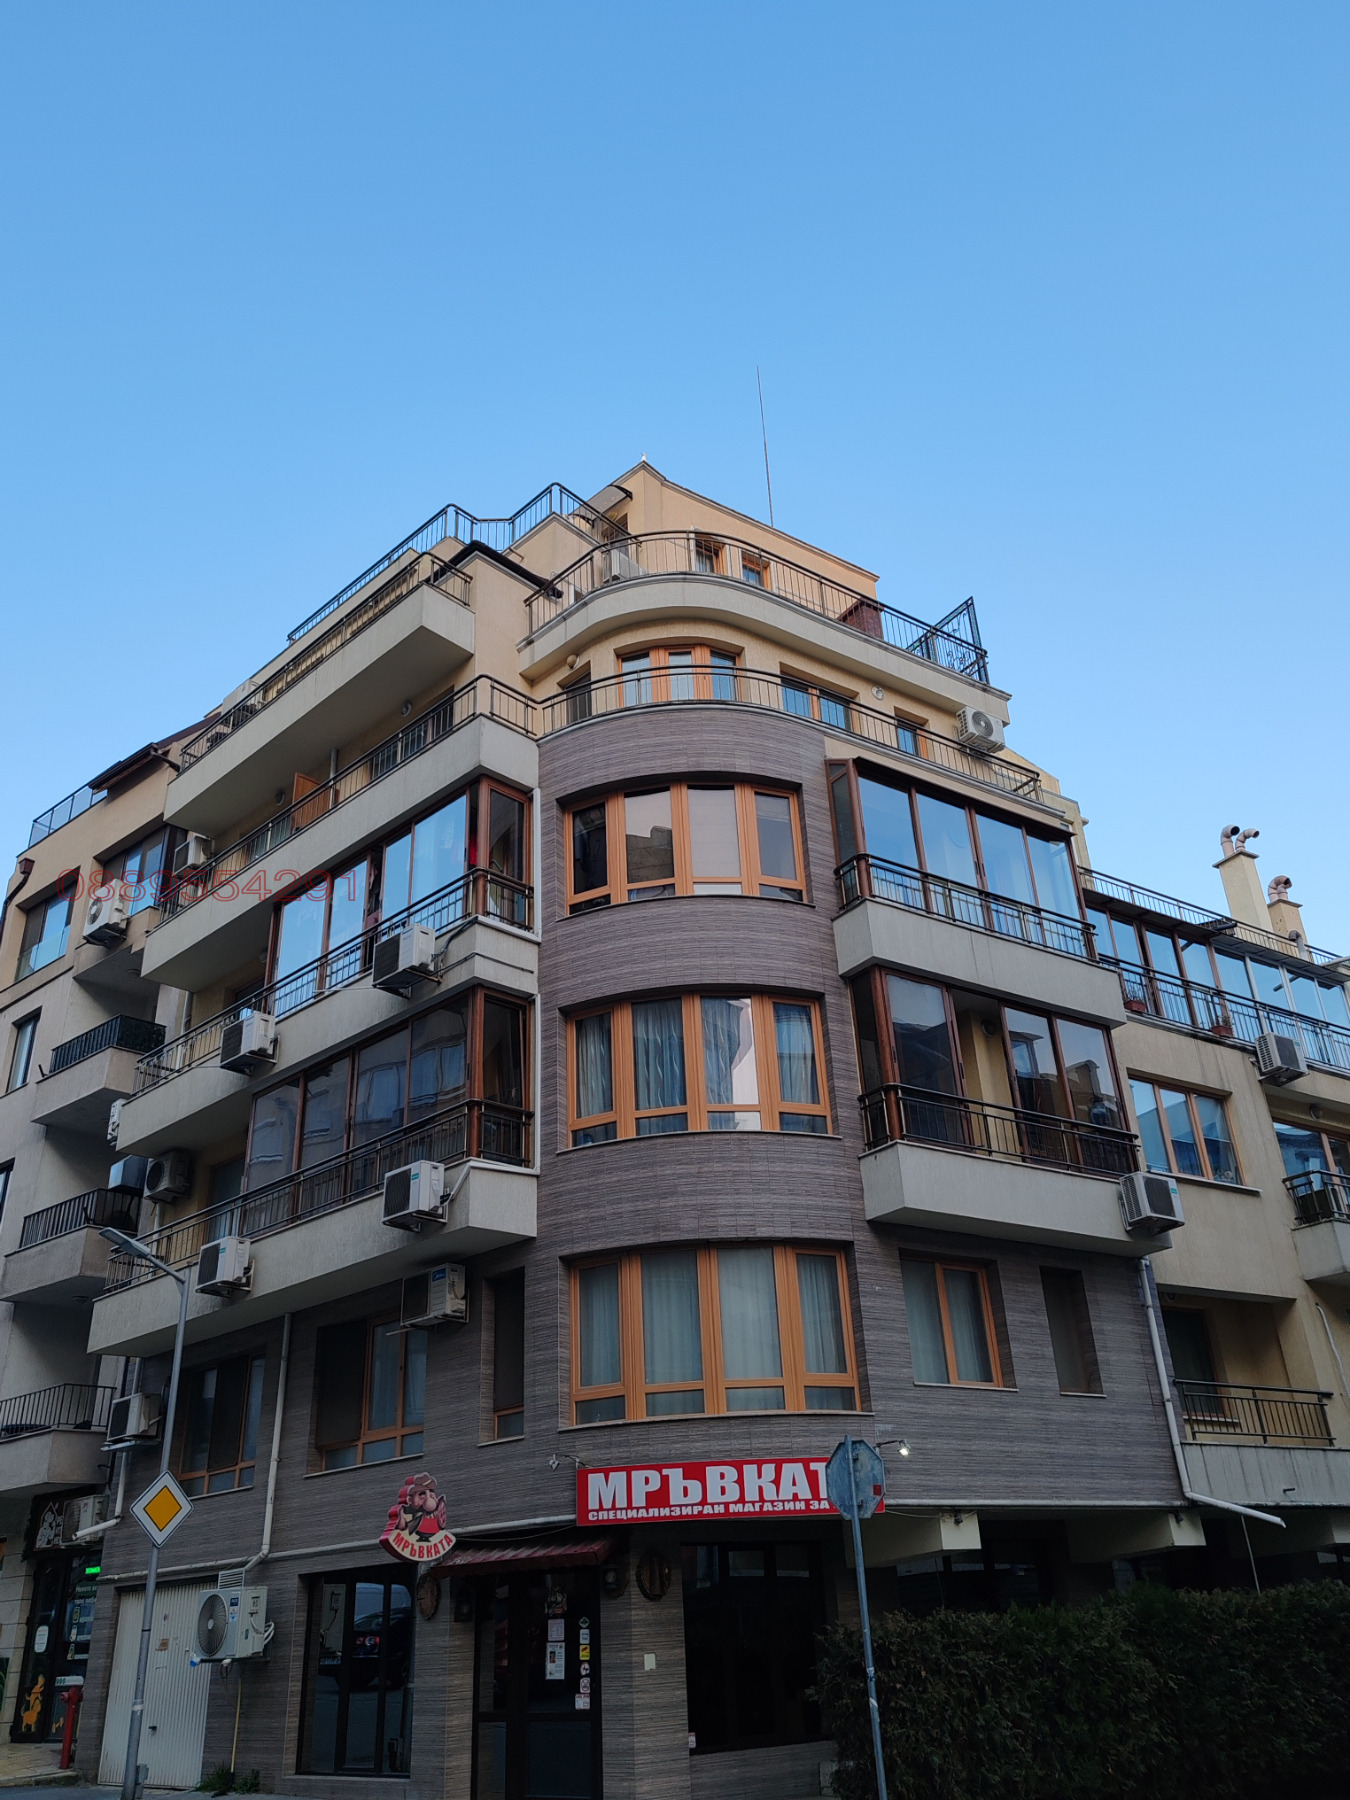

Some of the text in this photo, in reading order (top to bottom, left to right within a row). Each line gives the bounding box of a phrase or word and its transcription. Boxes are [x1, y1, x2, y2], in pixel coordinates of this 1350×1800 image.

[588, 1462, 828, 1510] МРЪВКАТ
[588, 1504, 725, 1521] СПЕЦИАЛИЗИРАН
[729, 1501, 806, 1513] МАГАЗИН
[809, 1500, 830, 1510] ЗА
[393, 1532, 453, 1559] МРЪВКАТА
